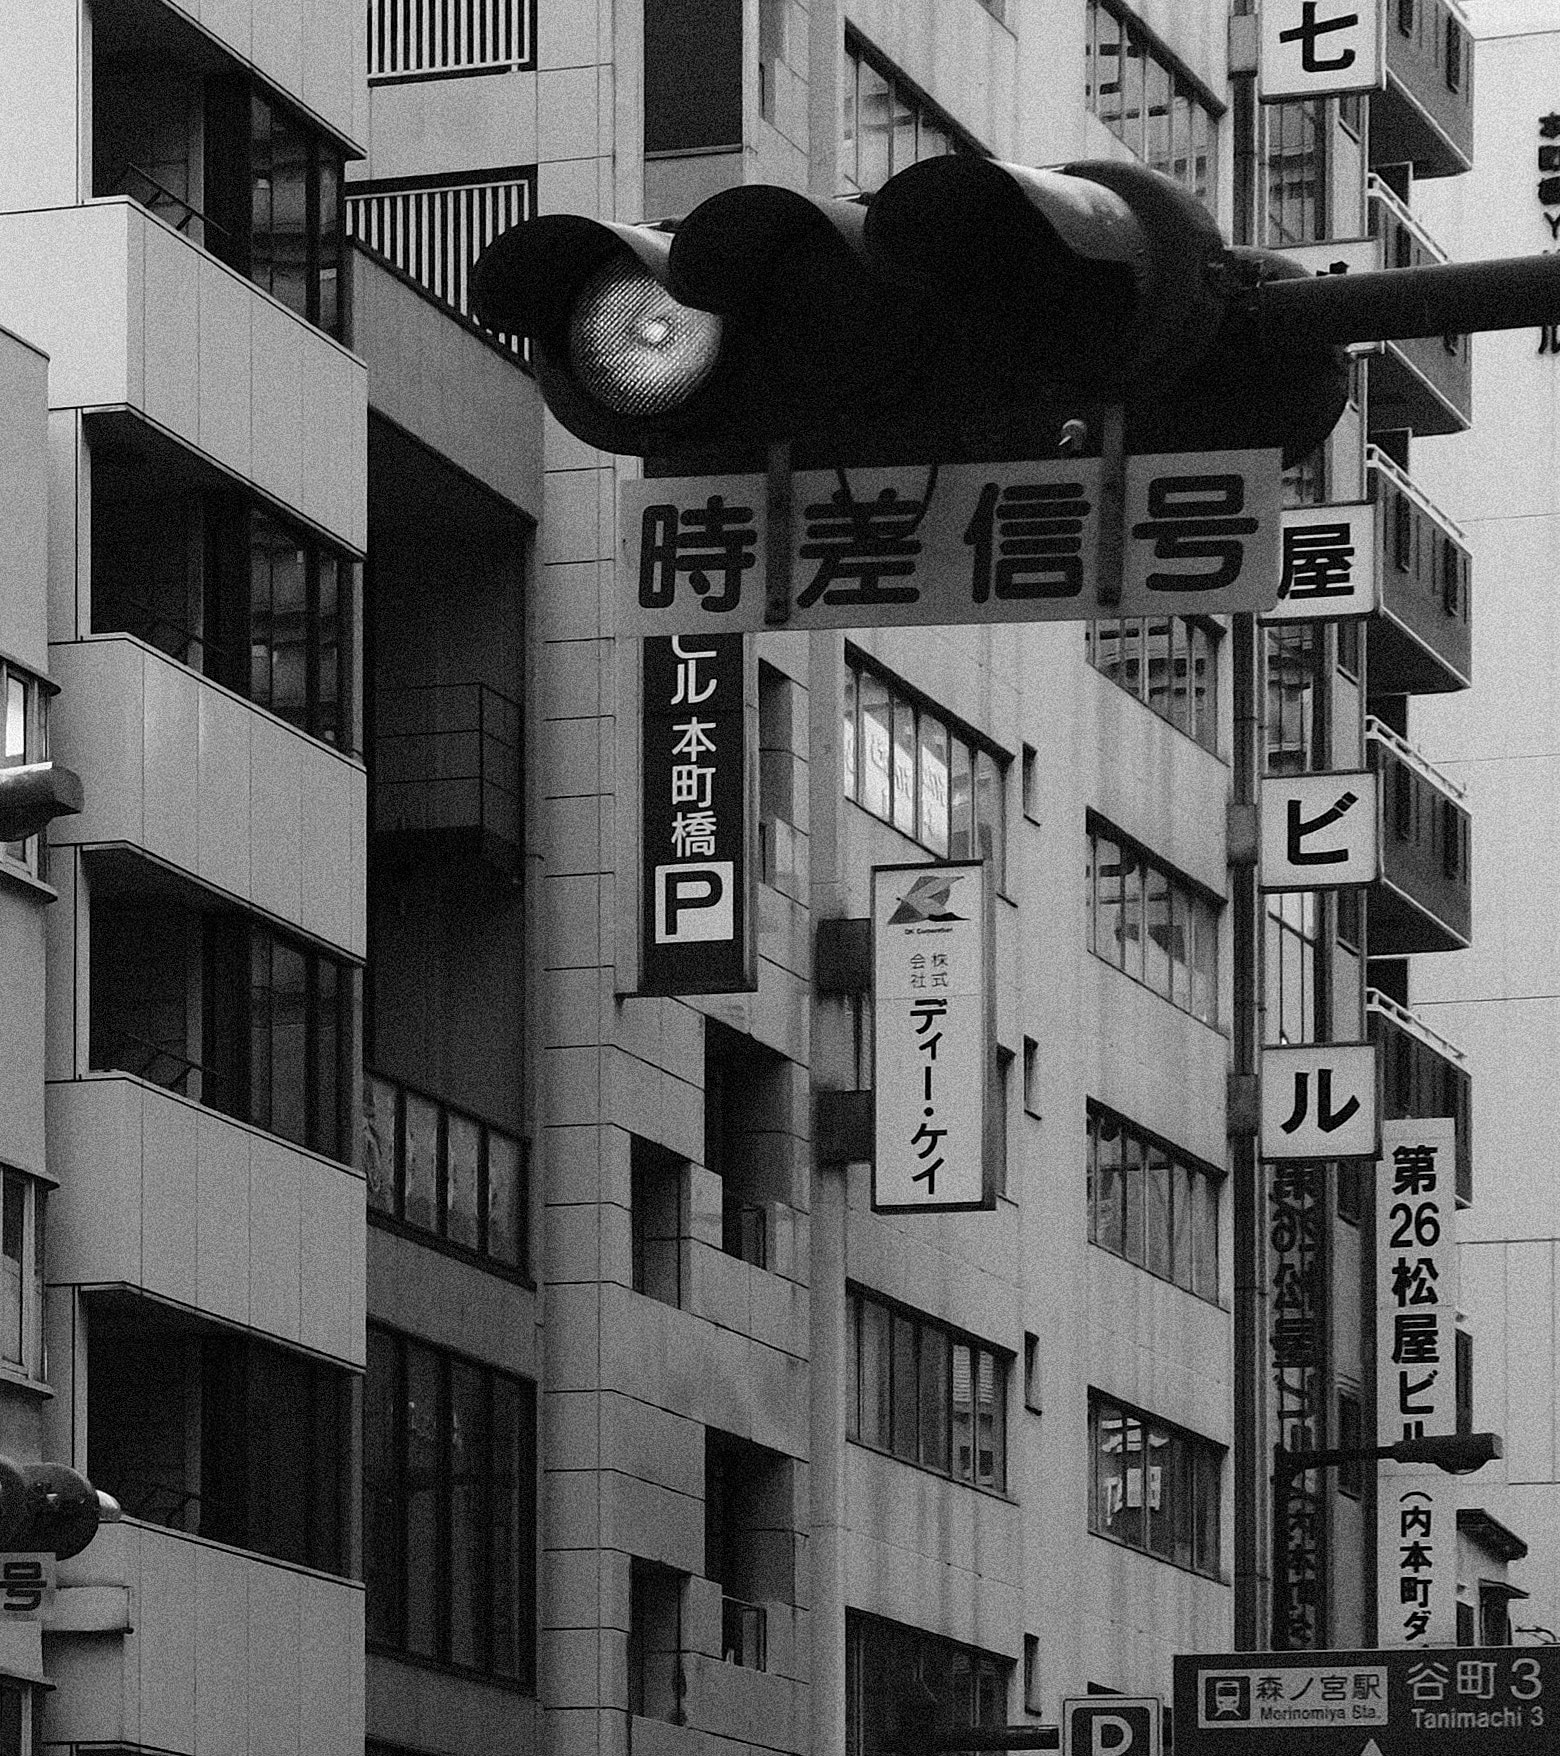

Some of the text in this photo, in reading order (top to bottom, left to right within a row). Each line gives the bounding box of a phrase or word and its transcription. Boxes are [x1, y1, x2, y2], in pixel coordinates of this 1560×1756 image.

[637, 473, 1258, 614] 時差信号
[665, 870, 724, 936] P
[910, 999, 948, 1195] ディー・ケイ
[1256, 1674, 1380, 1702] 森ノ宮駅
[1260, 1706, 1345, 1722] Morinomiya
[1411, 1707, 1544, 1729] Tanimachi 3
